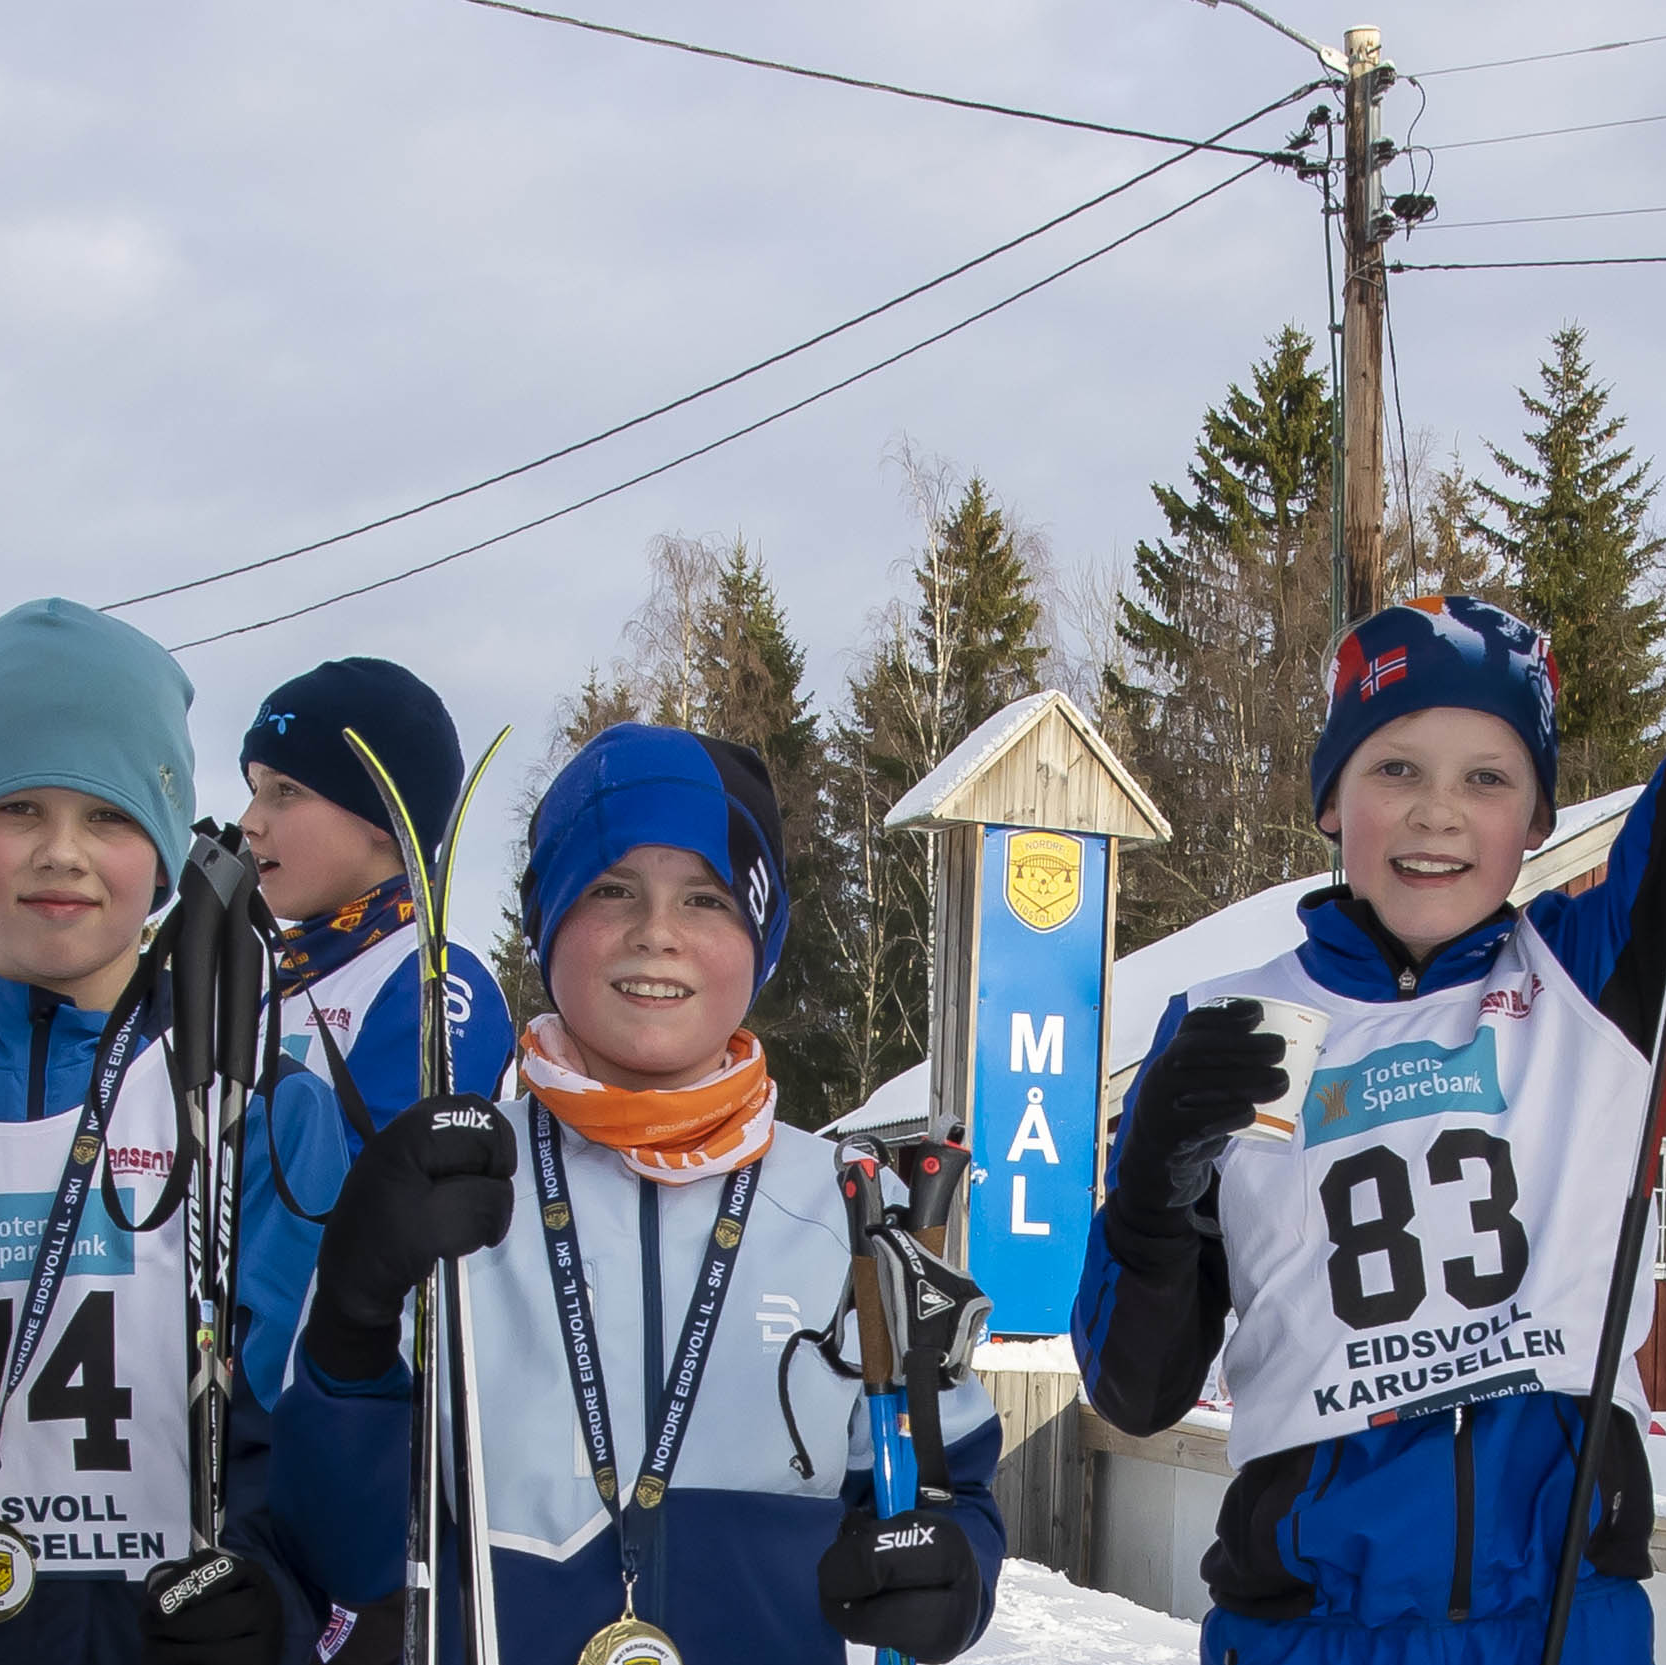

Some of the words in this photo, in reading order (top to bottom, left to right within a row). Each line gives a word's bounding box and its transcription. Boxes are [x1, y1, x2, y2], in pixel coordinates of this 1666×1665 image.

[1362, 1057, 1443, 1088] Totens
[1362, 1070, 1482, 1112] Sparebank
[538, 1138, 560, 1199] NORDRE
[32, 1238, 66, 1315] EIDSVOLL
[55, 1214, 72, 1233] IL
[64, 1178, 83, 1205] SKI
[555, 1241, 572, 1267] SKI
[1319, 1128, 1530, 1331] 83
[563, 1279, 578, 1296] IL
[9, 1318, 41, 1387] NORDRE
[565, 1298, 595, 1383] EIDSVOLL
[652, 1396, 685, 1473] NORDRE
[674, 1315, 710, 1398] EIDSVOLL
[700, 1298, 716, 1316] IL
[708, 1260, 726, 1288] SKI
[1346, 1302, 1533, 1370] EIDSVOLL
[1313, 1328, 1566, 1416] KARUSELLEN
[583, 1385, 607, 1462] NORDRE
